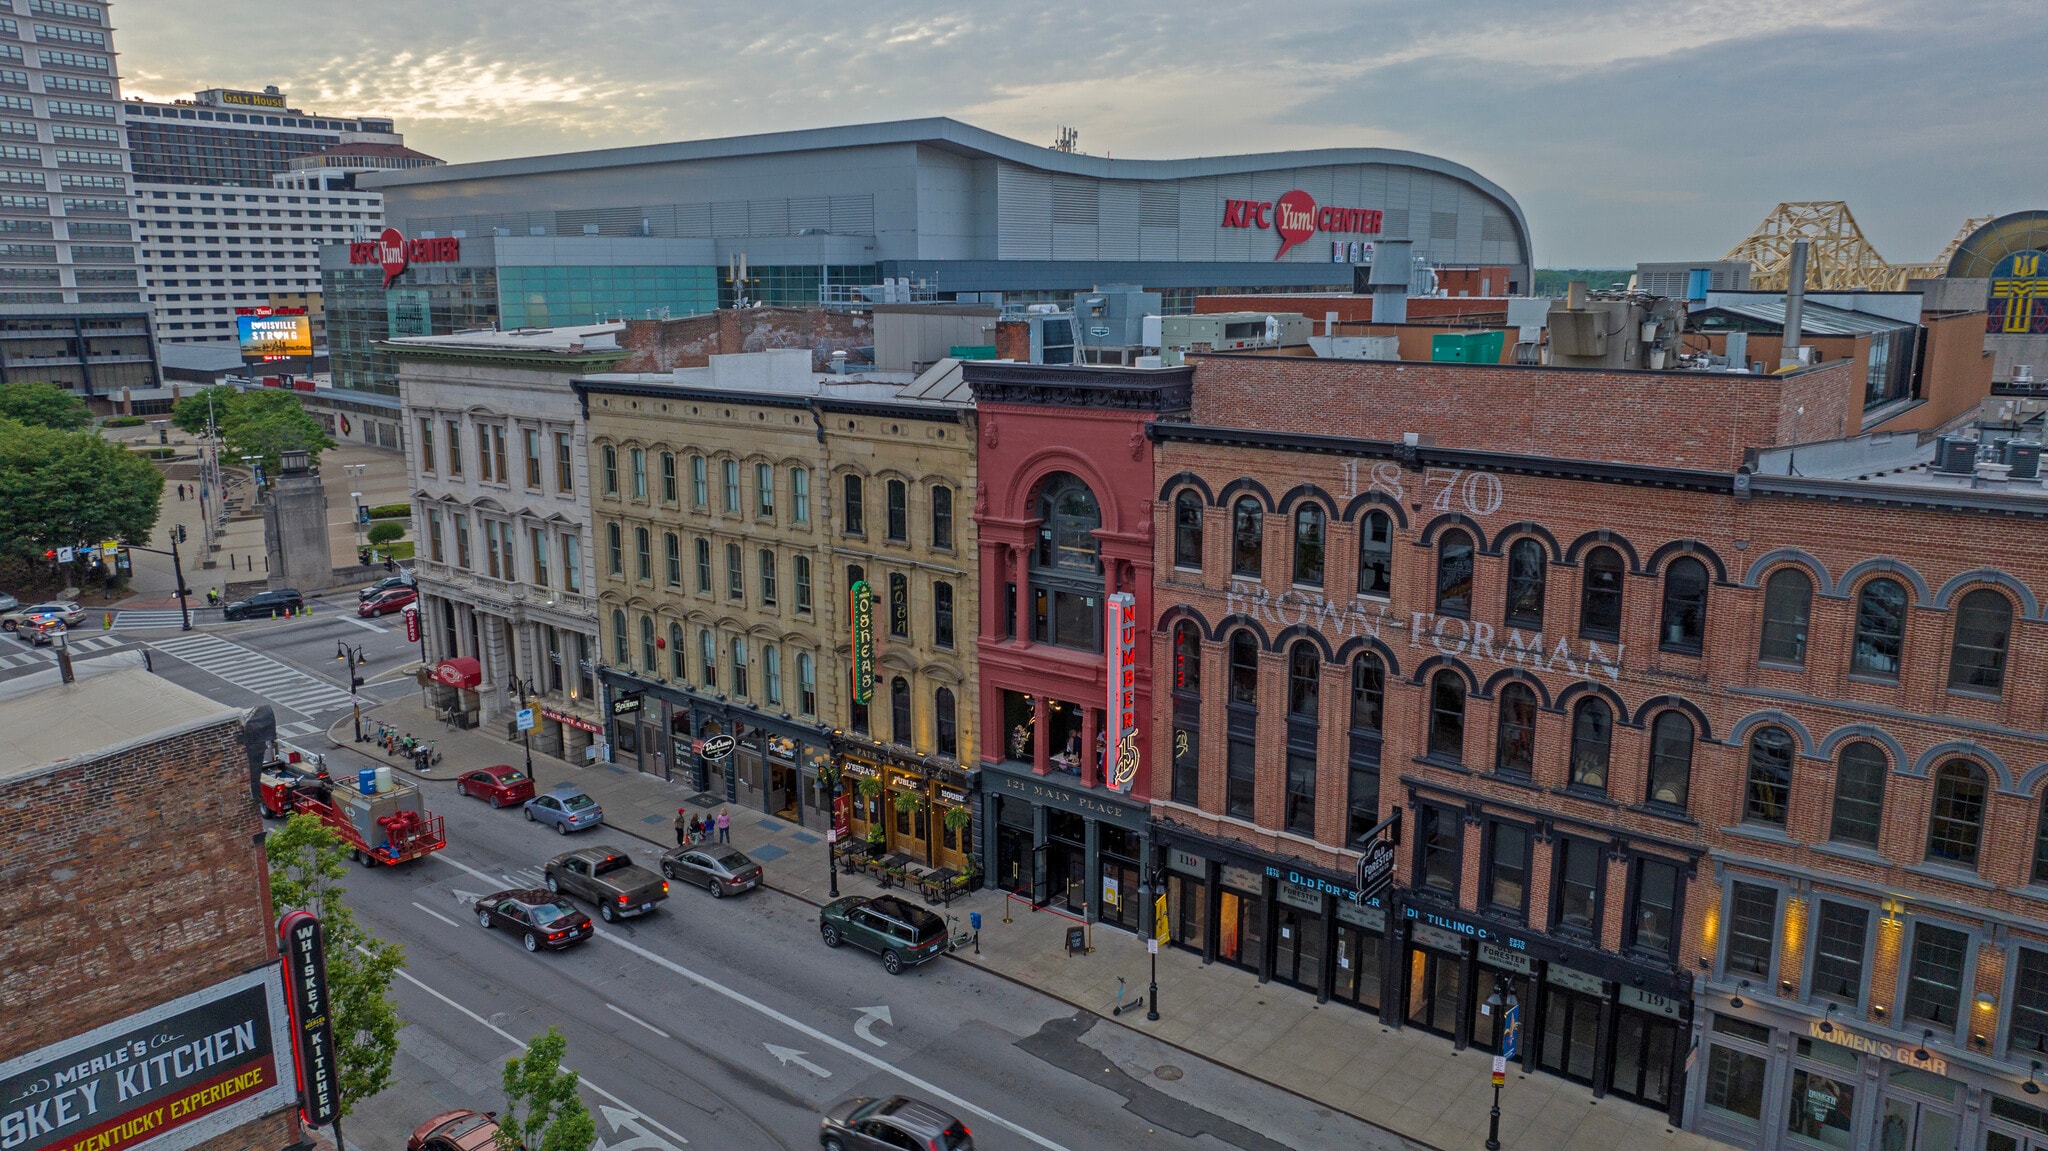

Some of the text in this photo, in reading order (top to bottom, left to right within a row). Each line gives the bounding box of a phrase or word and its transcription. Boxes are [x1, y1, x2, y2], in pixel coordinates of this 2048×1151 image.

[223, 92, 283, 107] GALT HOUSE
[1223, 198, 1383, 234] KFC Yum! CENTER
[349, 237, 459, 264] KFC Yum! CENTER
[1122, 604, 1135, 730] NUMBER
[1115, 728, 1141, 786] 15
[1006, 779, 1122, 817] 121 MAIN PLACE
[1180, 854, 1197, 867] 119
[1283, 885, 1319, 903] FORESTER
[1289, 871, 1315, 889] OLD
[1406, 907, 1475, 936] DITILLING
[296, 924, 320, 1014] WHISKEY
[1483, 945, 1526, 965] FORESTER
[1638, 990, 1664, 1007] 119
[54, 1038, 148, 1089] MERLE'S
[1809, 1022, 1947, 1077] WOMEN'S GEAR
[0, 1019, 257, 1150] SKEY KITCHEN
[311, 1032, 332, 1118] KITCHEN
[73, 1066, 263, 1151] KENTUCKY EXPERIENCE
